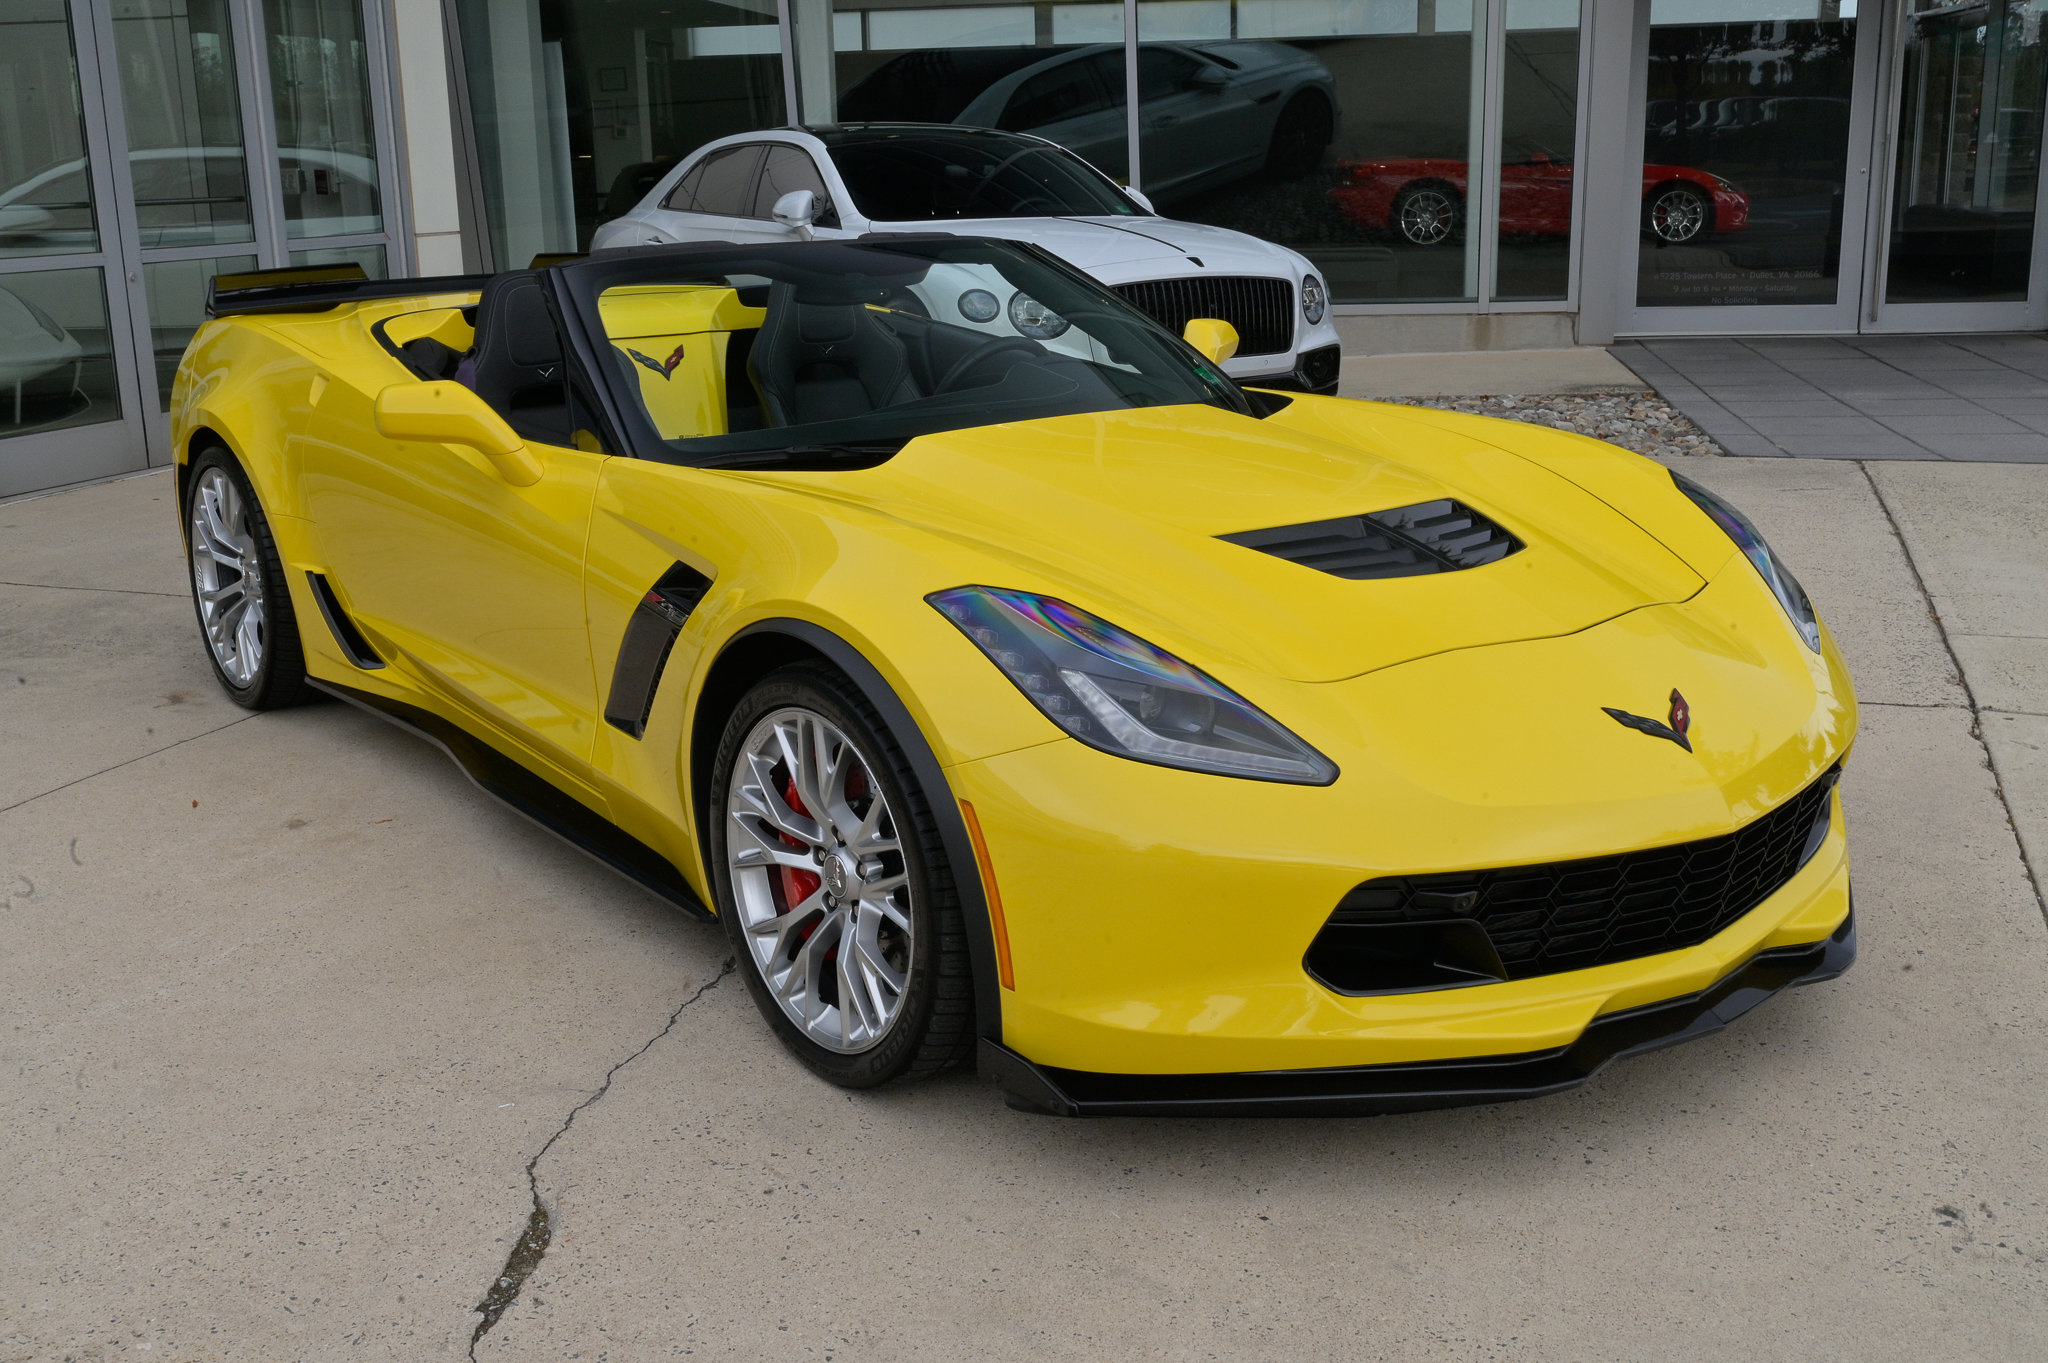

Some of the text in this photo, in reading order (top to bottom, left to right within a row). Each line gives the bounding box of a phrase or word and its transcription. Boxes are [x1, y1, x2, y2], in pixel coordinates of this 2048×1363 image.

[1715, 271, 1737, 280] Place
[1778, 271, 1790, 279] VA
[1794, 270, 1820, 279] 20166
[1728, 285, 1758, 294] Monday
[1764, 284, 1797, 294] Saturday
[1724, 296, 1758, 305] Soliciting
